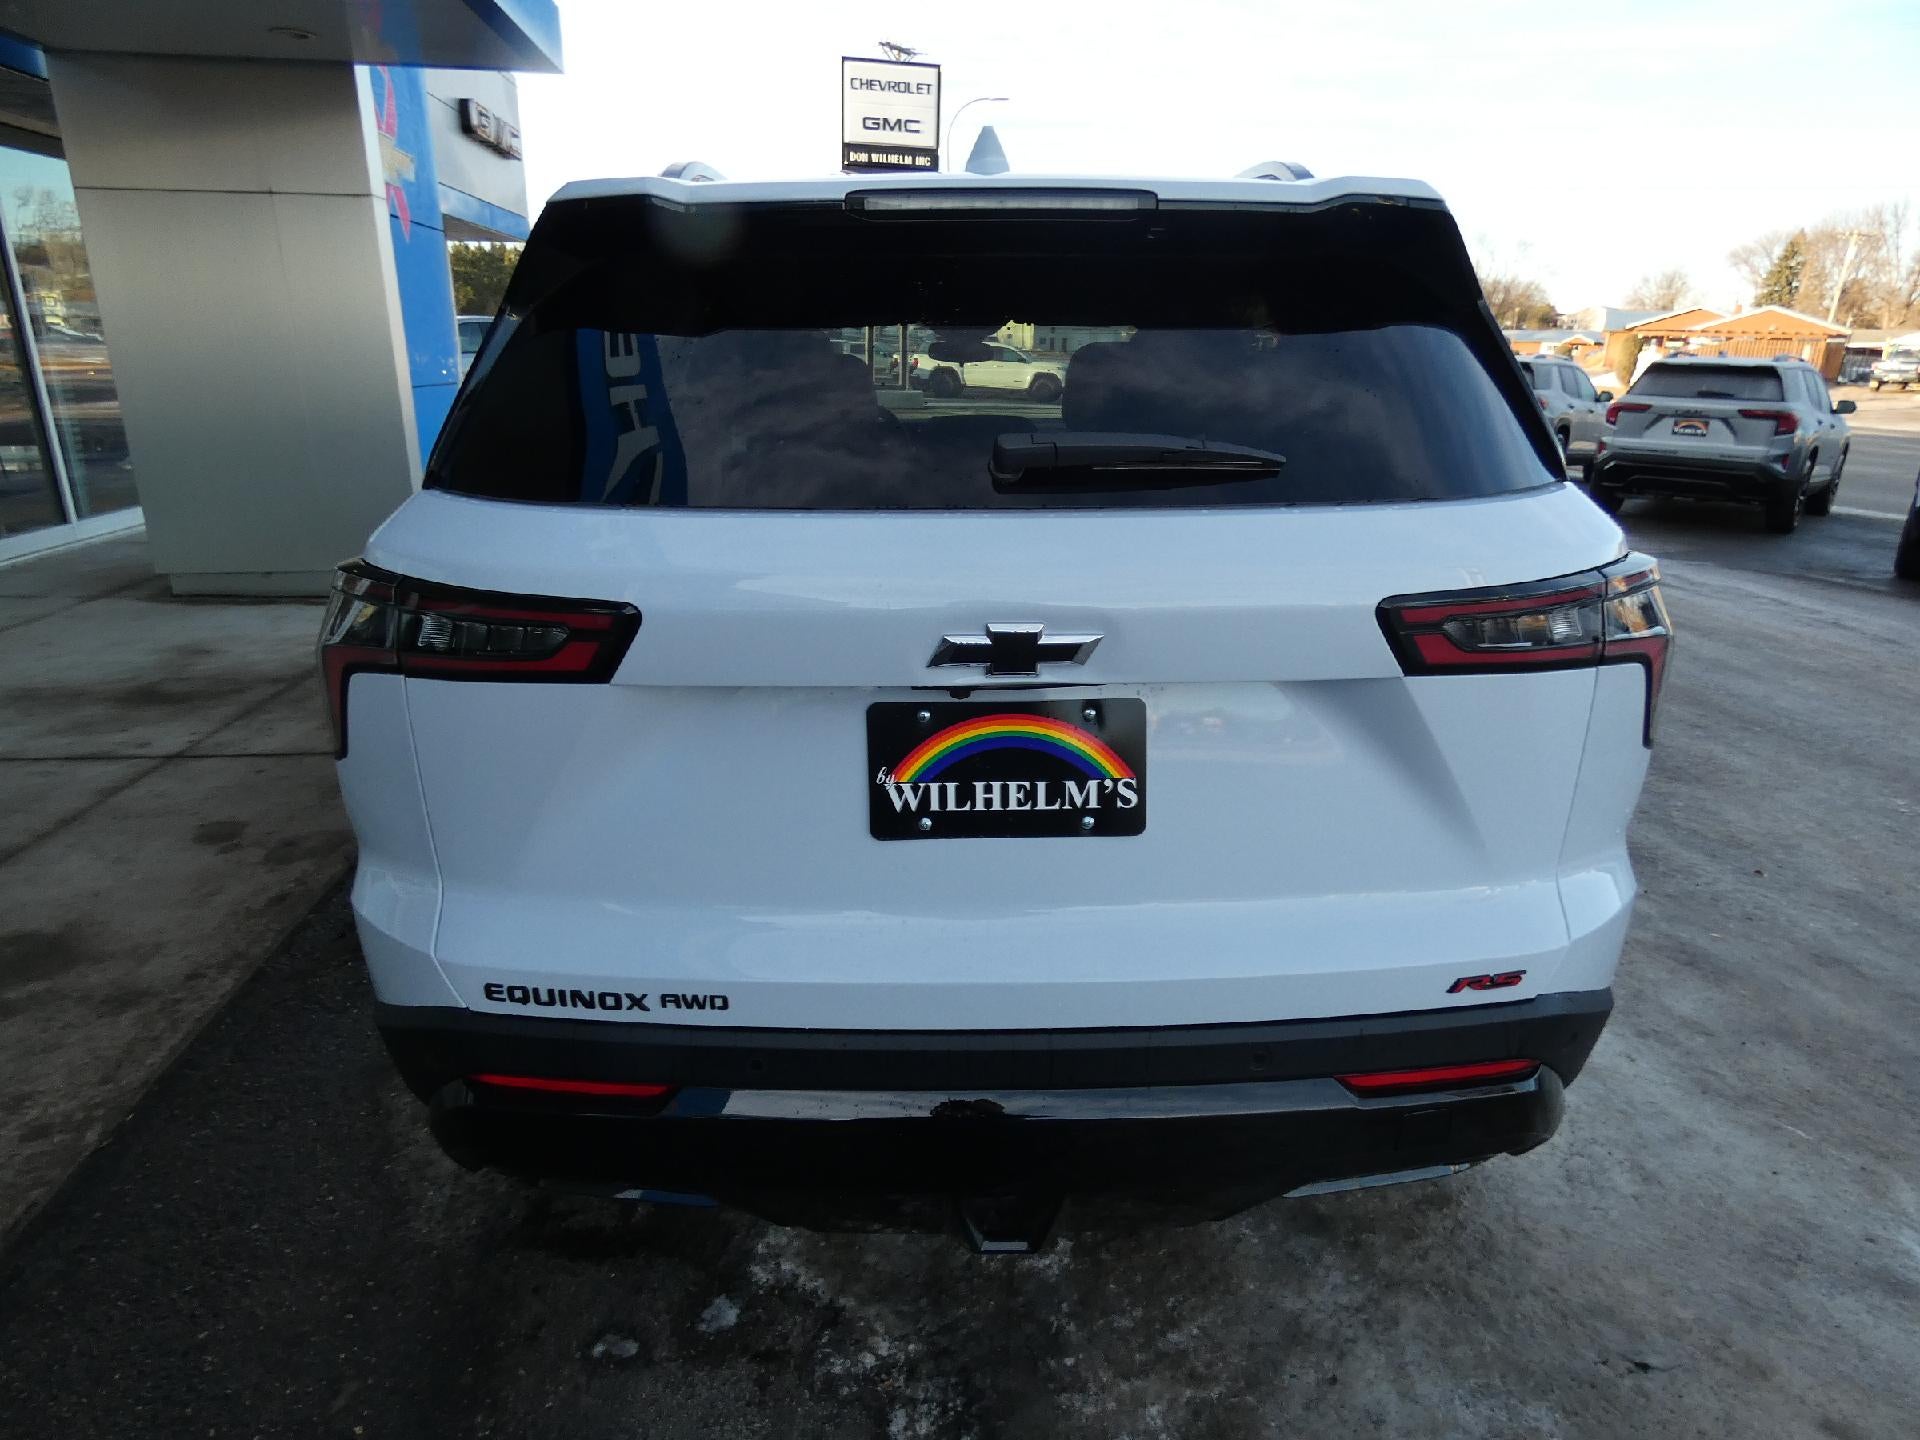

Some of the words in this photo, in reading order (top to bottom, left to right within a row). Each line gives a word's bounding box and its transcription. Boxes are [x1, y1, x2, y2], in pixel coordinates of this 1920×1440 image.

[850, 77, 933, 95] CHEVROLET
[862, 116, 921, 134] GMC
[849, 151, 869, 163] DON
[871, 153, 913, 165] WILHELM
[915, 155, 931, 167] INC
[876, 766, 897, 790] by
[884, 777, 1139, 813] WILHELM'S
[1446, 969, 1527, 994] RS
[484, 982, 651, 1012] EQUINOX
[660, 993, 730, 1011] AWD
